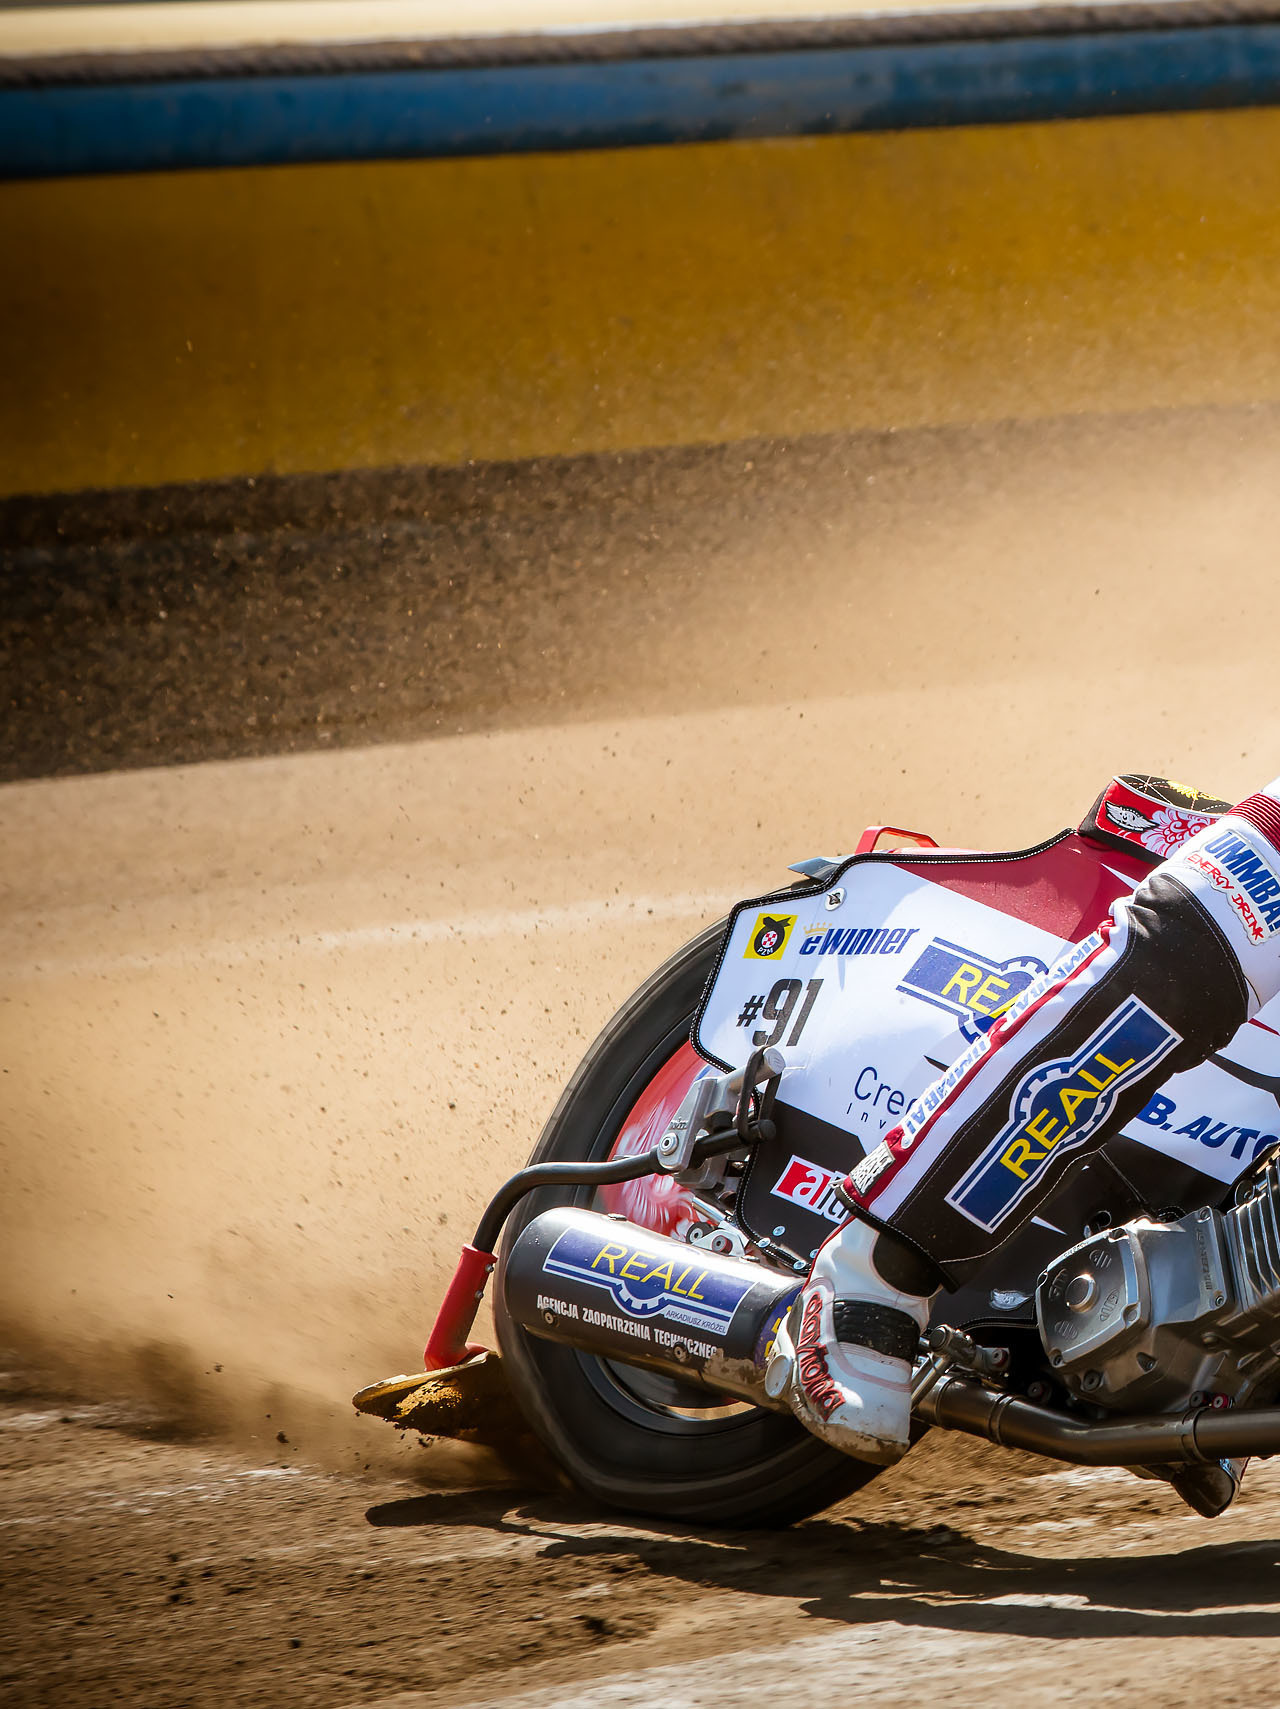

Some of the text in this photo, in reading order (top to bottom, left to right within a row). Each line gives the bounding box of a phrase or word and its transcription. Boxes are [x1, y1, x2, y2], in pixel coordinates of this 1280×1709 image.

[1000, 1051, 1136, 1181] REALL
[591, 1243, 706, 1301] REALL
[536, 1294, 718, 1359] AGENCJA ZAOPATRZENIA TECHNICZNEG
[665, 1309, 702, 1326] ARKADIUSZ
